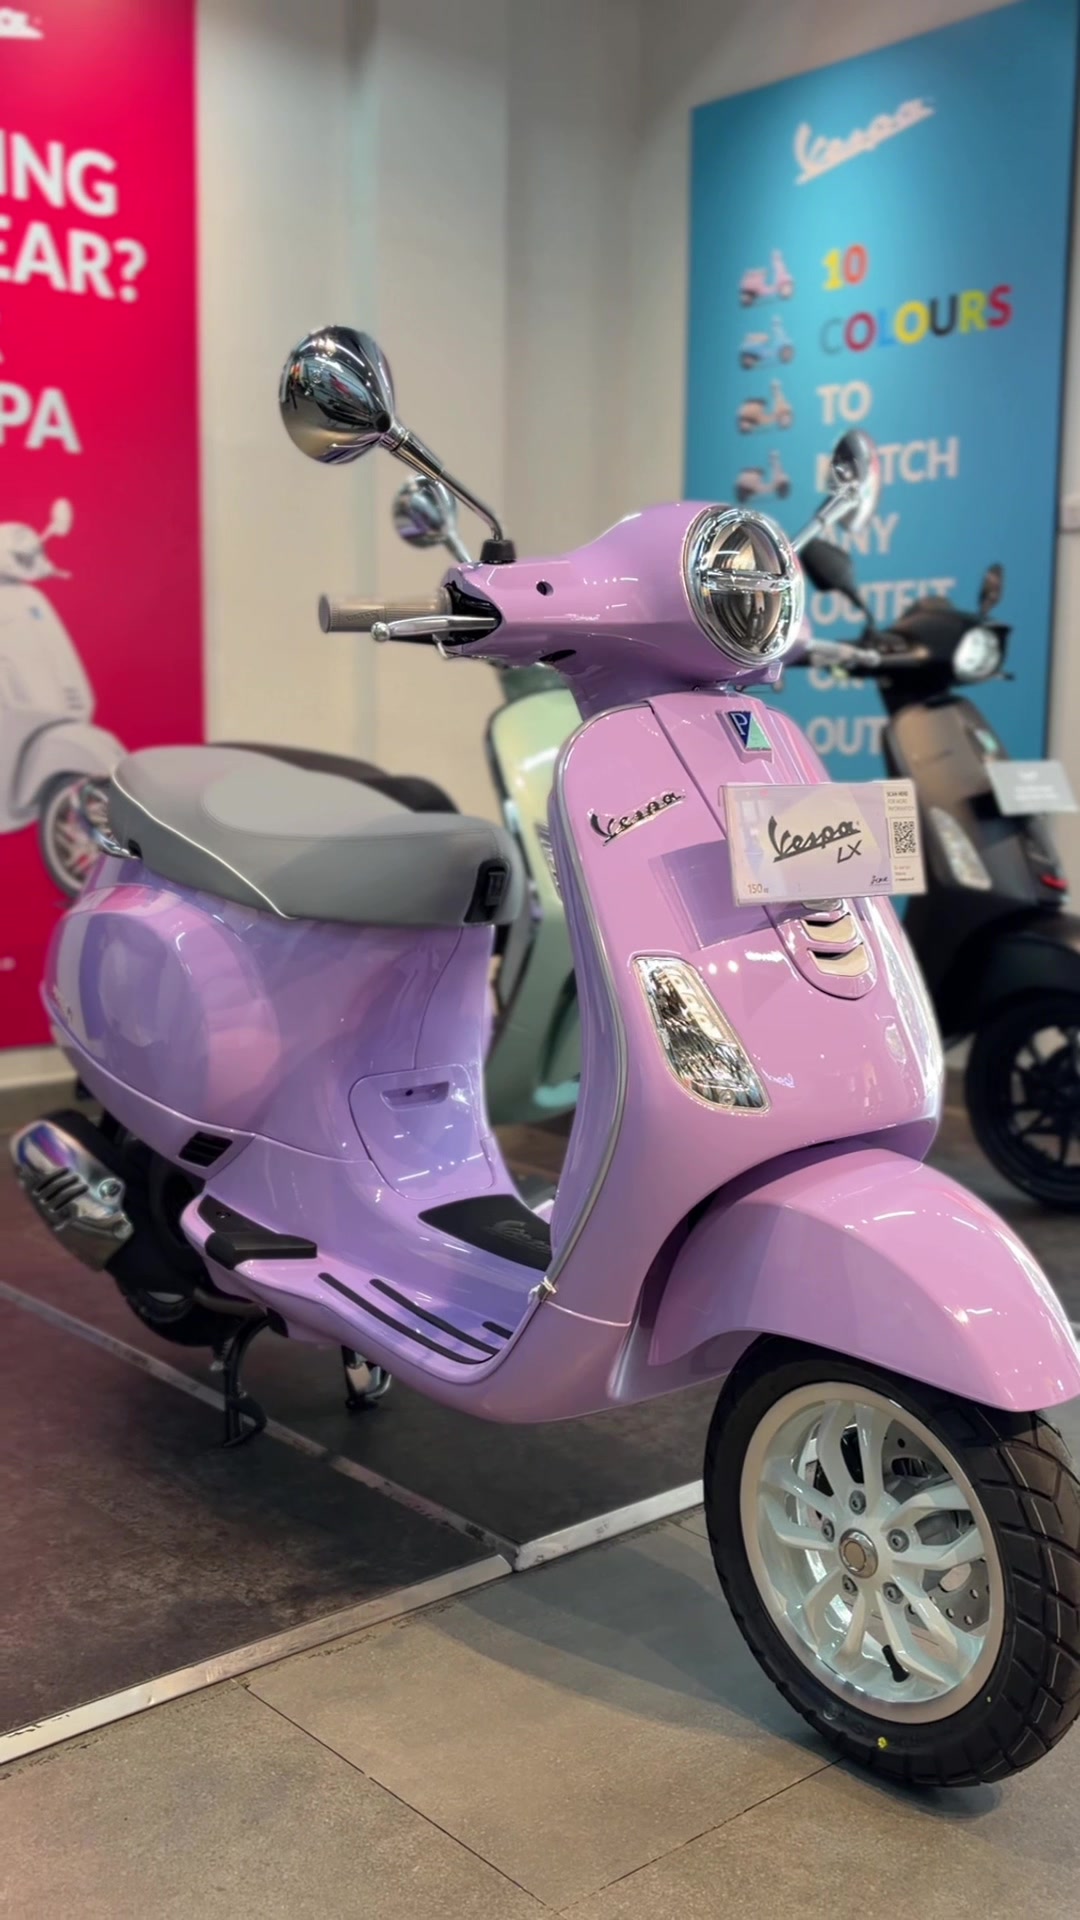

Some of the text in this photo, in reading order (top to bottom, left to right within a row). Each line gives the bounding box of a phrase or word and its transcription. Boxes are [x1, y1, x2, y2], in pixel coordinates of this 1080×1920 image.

[822, 244, 868, 290] 10
[820, 284, 1012, 354] COLOURS
[817, 379, 872, 425] TO
[815, 436, 959, 493] TCH
[590, 791, 687, 847] Vespa
[768, 816, 861, 863] Vespa
[837, 840, 862, 864] LX
